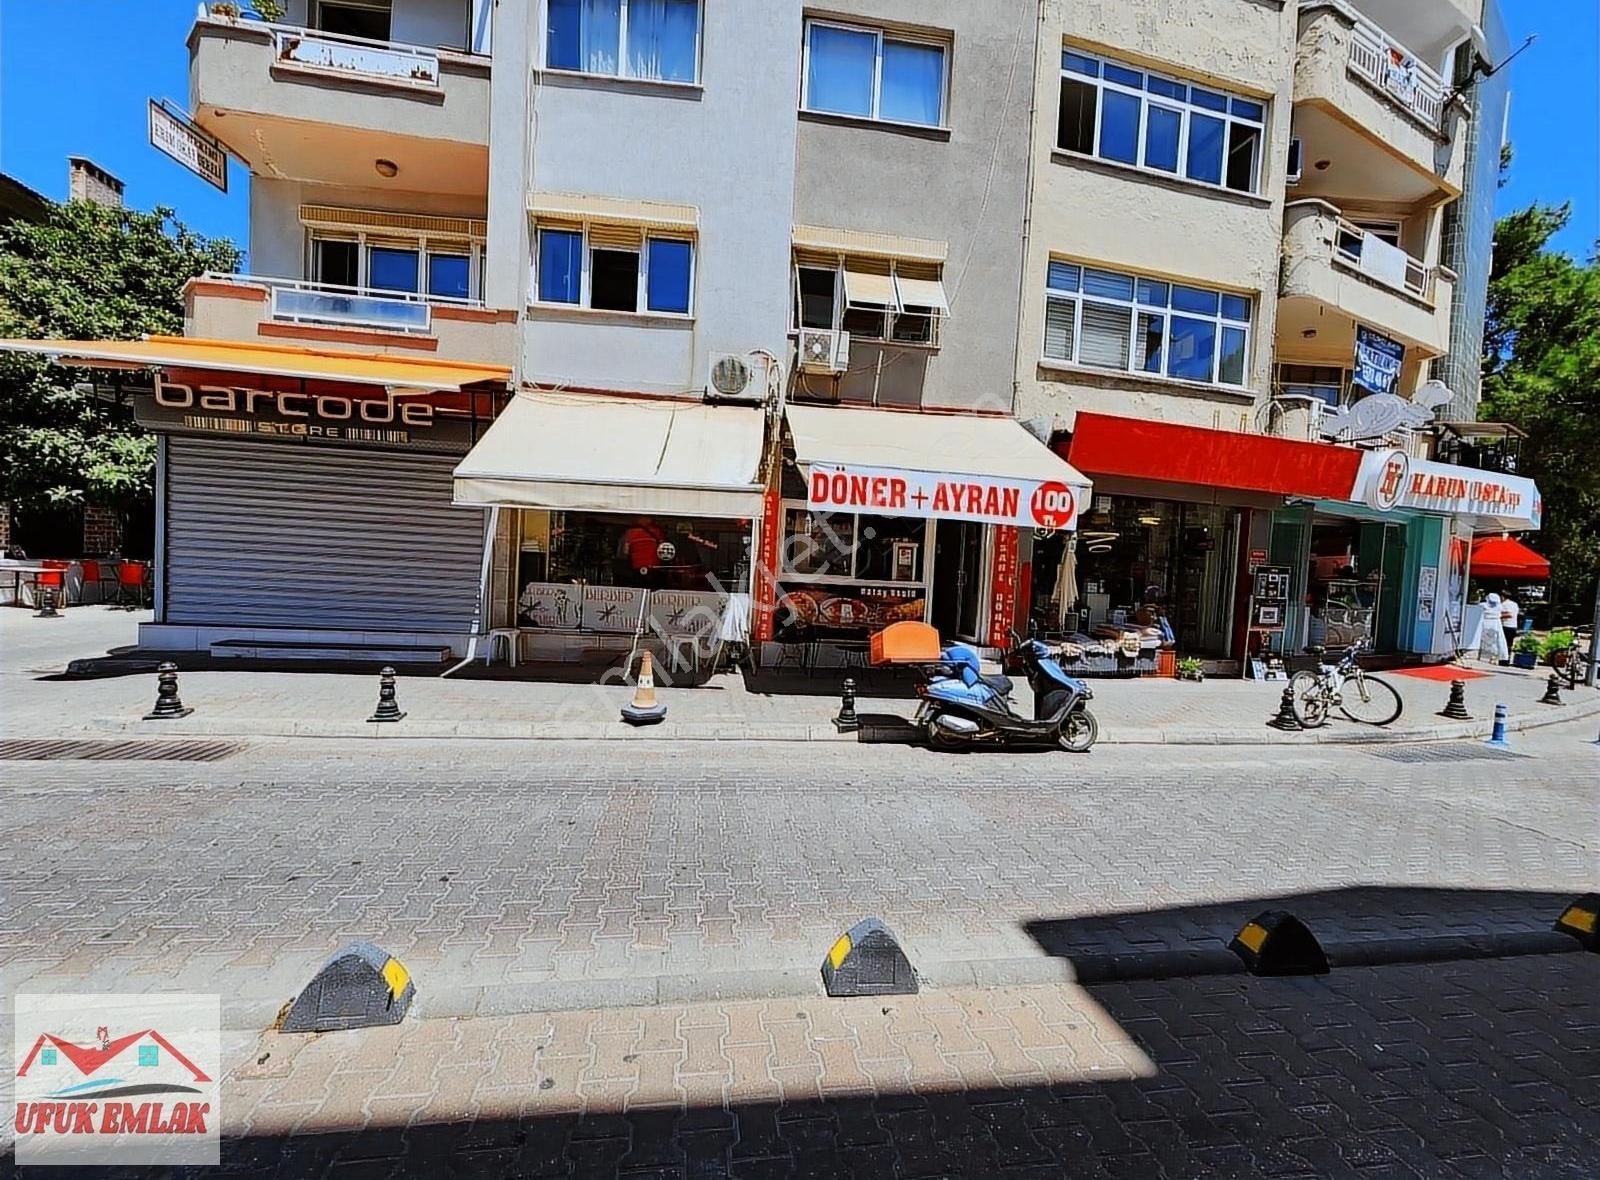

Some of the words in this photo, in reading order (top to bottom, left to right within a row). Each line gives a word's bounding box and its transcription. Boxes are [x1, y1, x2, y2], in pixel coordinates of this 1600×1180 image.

[155, 372, 433, 426] barcode
[811, 466, 907, 508] DÖNER
[932, 482, 1020, 518] AYRAN
[1034, 489, 1070, 512] 100
[1411, 473, 1467, 499] HARUN
